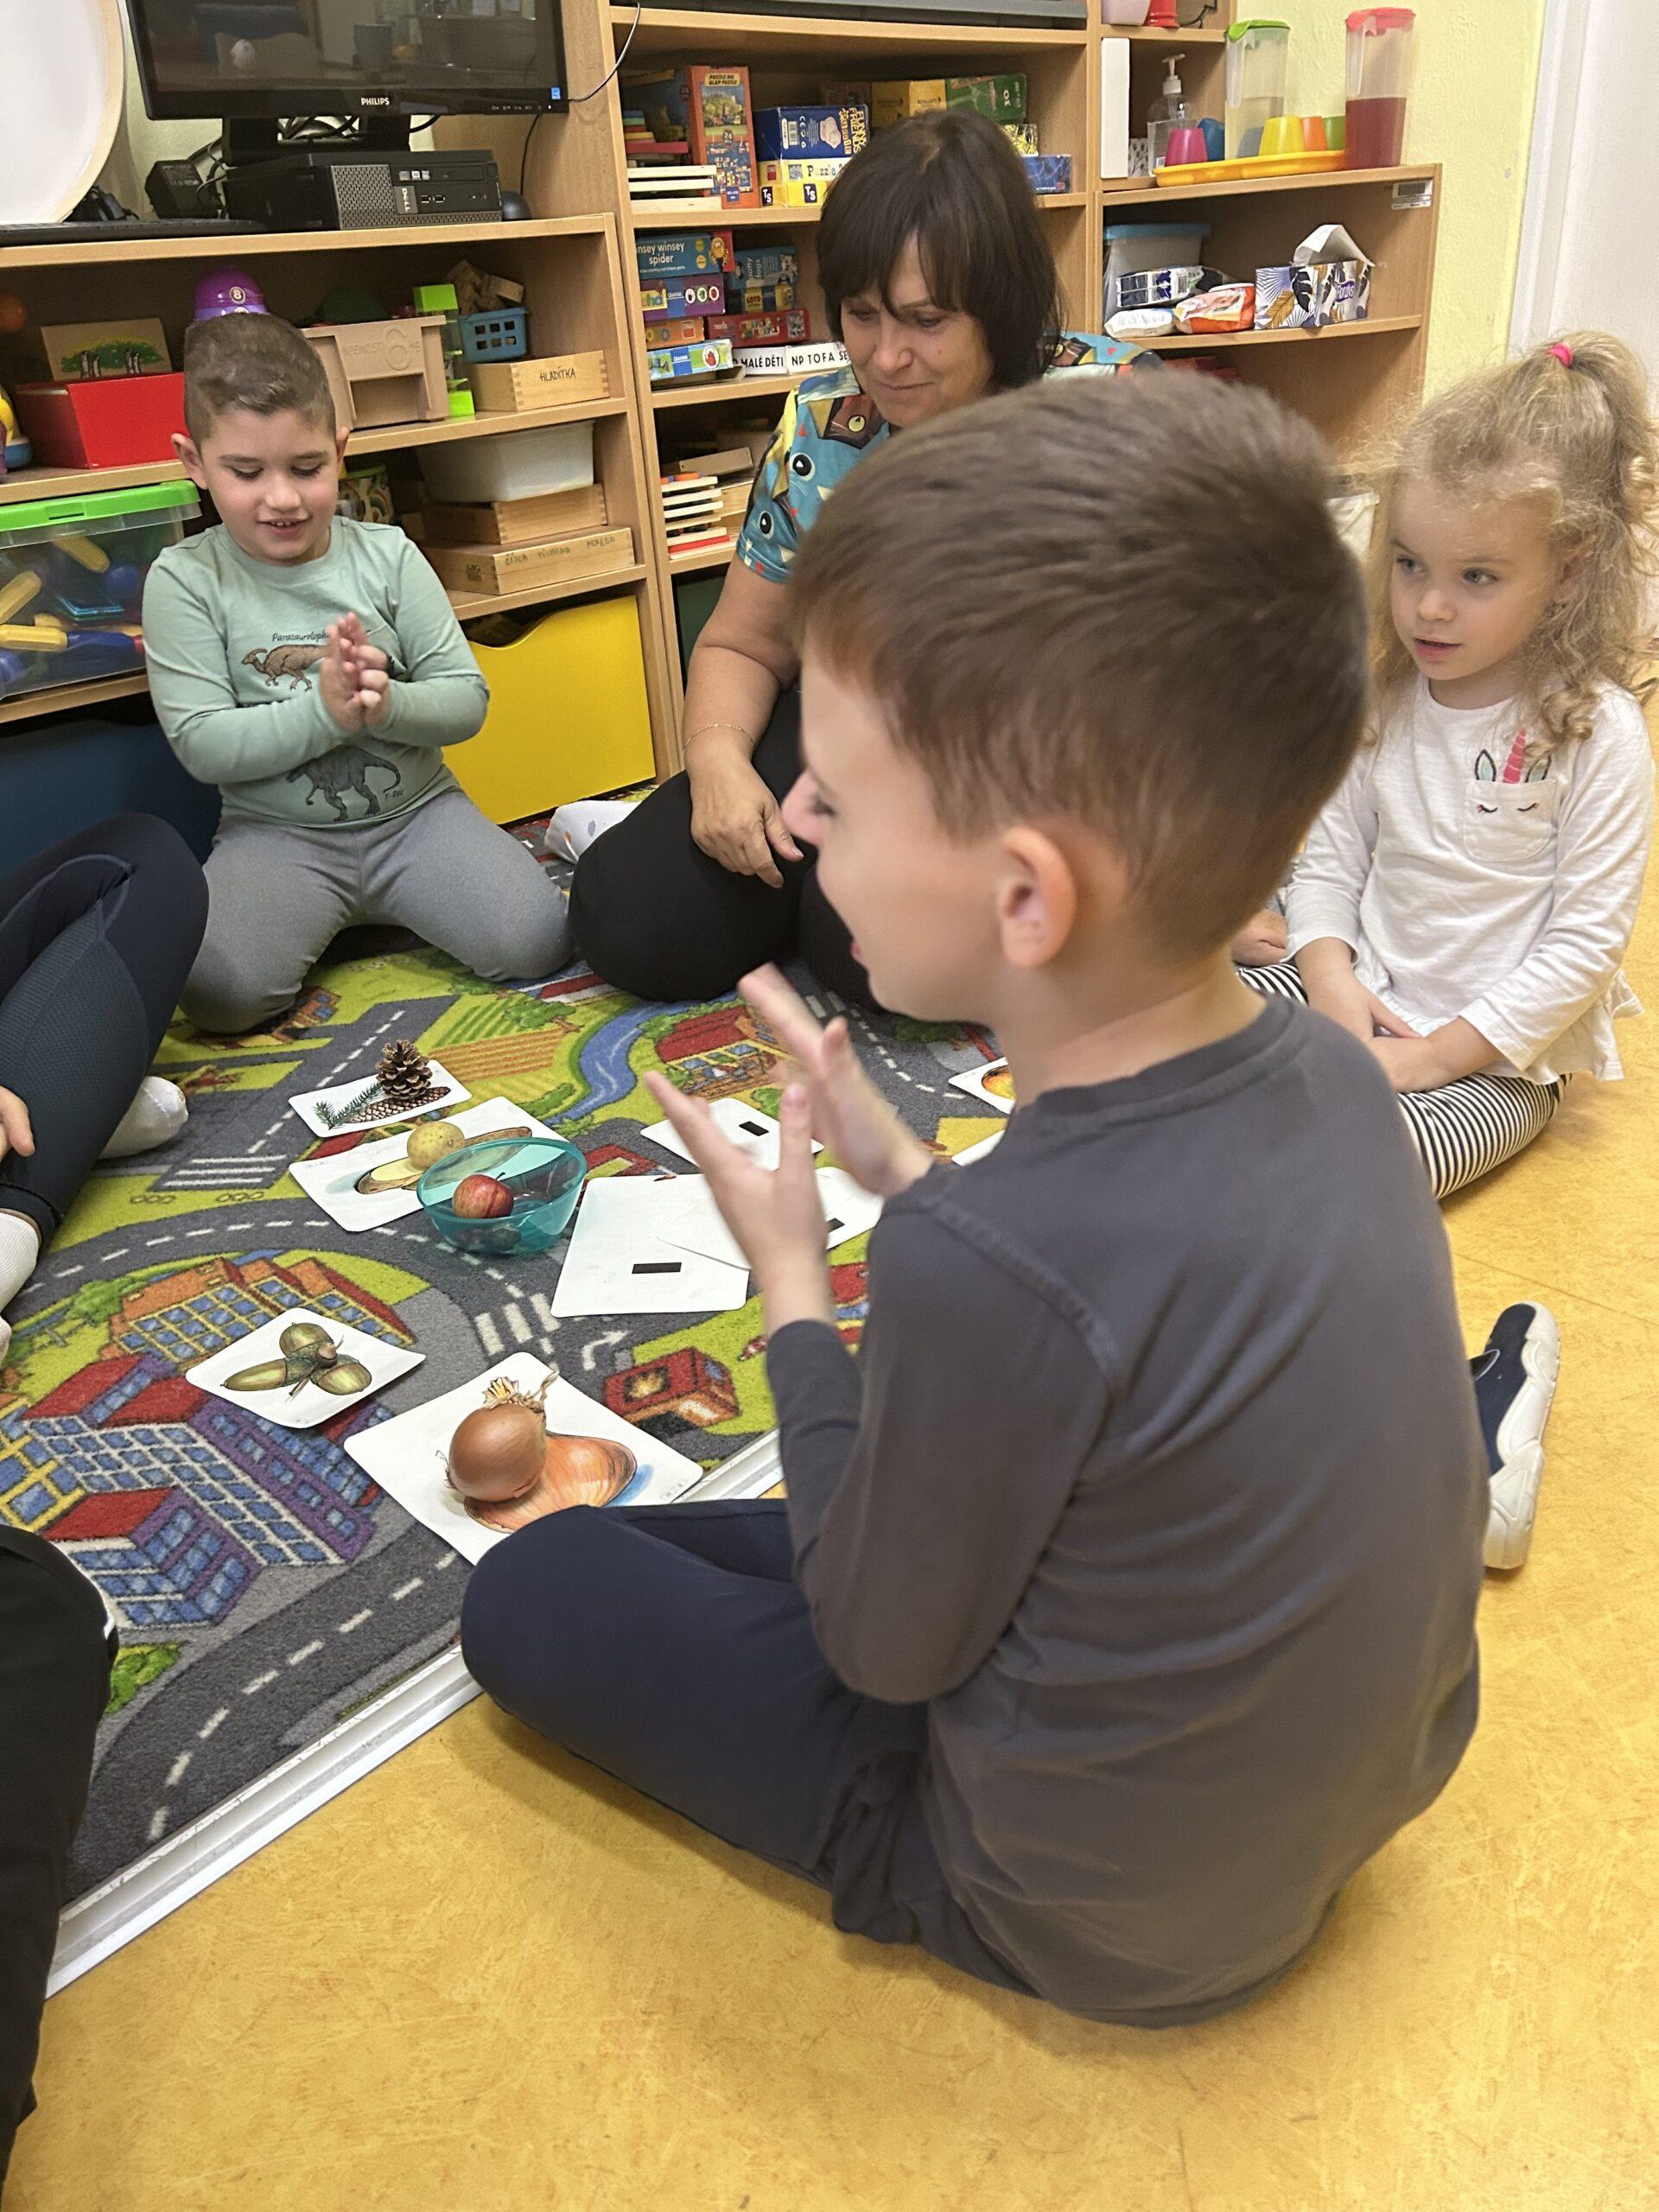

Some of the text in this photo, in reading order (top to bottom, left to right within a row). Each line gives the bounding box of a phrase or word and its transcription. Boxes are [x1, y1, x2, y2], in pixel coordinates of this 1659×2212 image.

[360, 97, 390, 105] PHILIPS
[849, 107, 861, 154] FRIENDS
[856, 110, 867, 148] FUNNY
[658, 242, 685, 253] winsey
[649, 252, 674, 266] spider
[232, 287, 242, 300] 8
[741, 356, 762, 367] MALÉ
[765, 355, 784, 367] DĚTI
[791, 356, 804, 366] NP
[539, 365, 576, 382] HLADÍTKA
